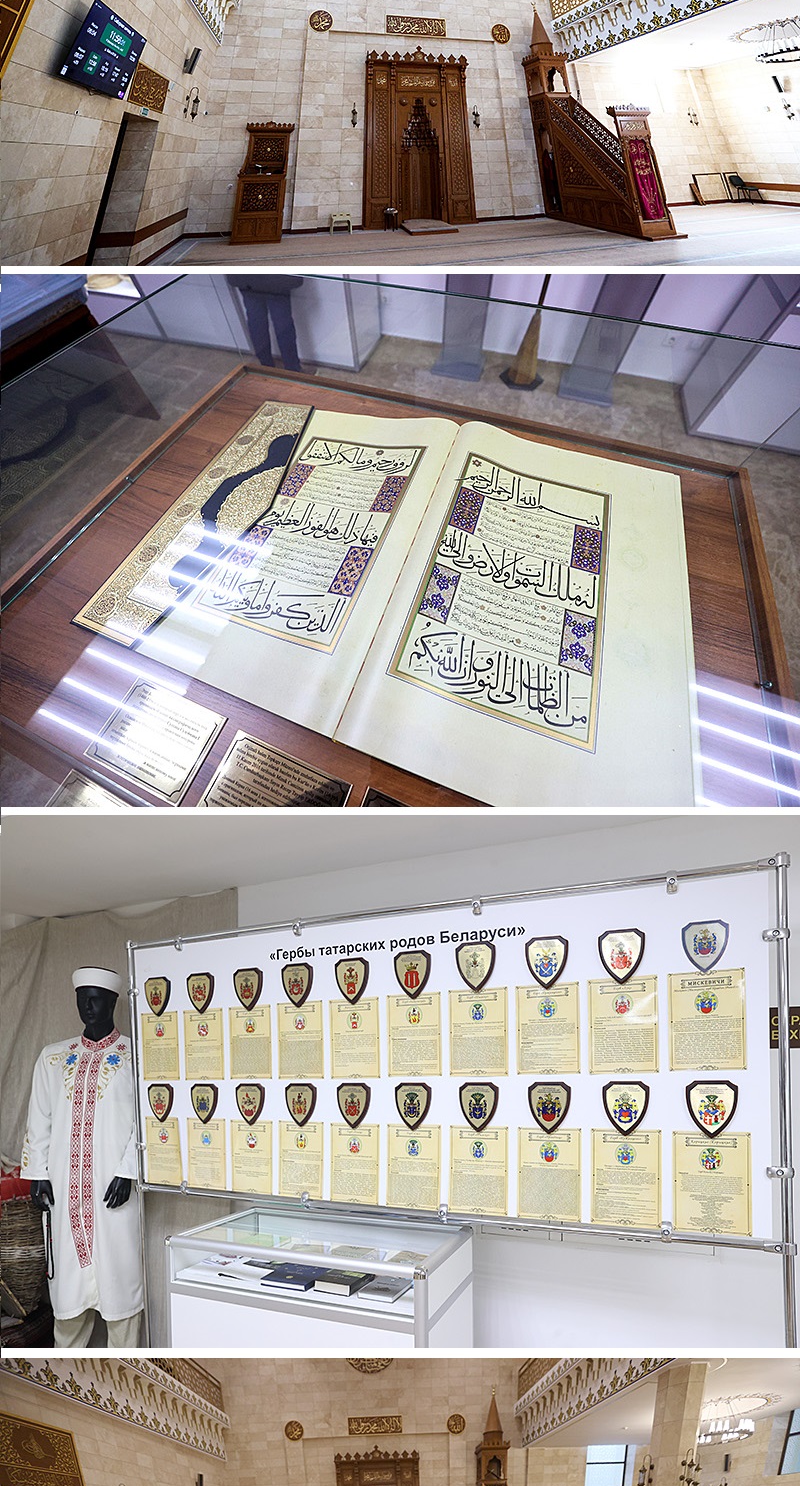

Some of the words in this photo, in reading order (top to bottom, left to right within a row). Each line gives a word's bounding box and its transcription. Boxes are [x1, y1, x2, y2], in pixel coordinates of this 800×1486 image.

[269, 943, 315, 962] «Гербы
[319, 940, 386, 958] татарских
[390, 931, 435, 952] родов
[440, 925, 526, 945] Беларуси»
